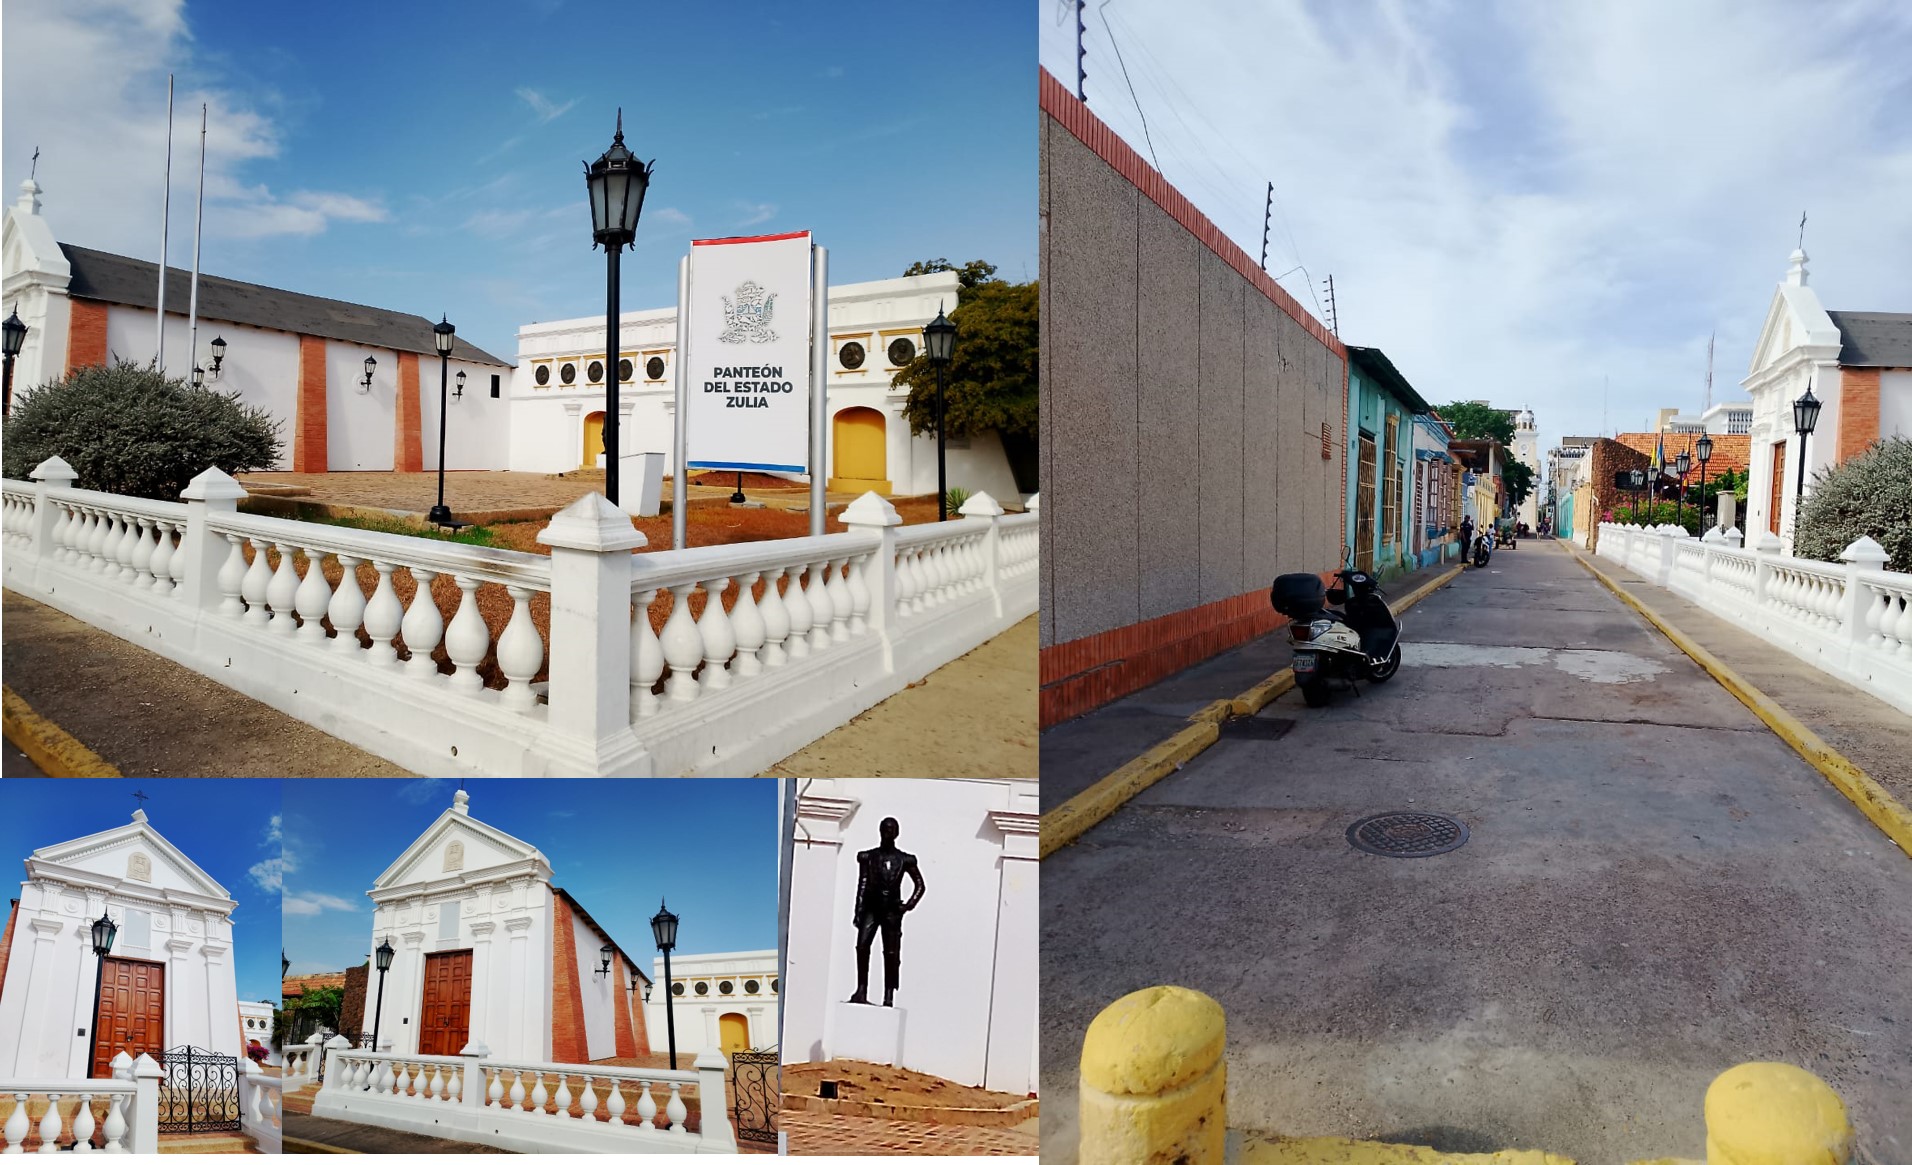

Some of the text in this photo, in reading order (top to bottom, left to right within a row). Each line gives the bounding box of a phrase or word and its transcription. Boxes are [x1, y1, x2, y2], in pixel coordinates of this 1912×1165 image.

[713, 363, 783, 379] PANTEÓN
[703, 381, 793, 394] DEL ESTADO
[726, 396, 769, 409] ZULIA
